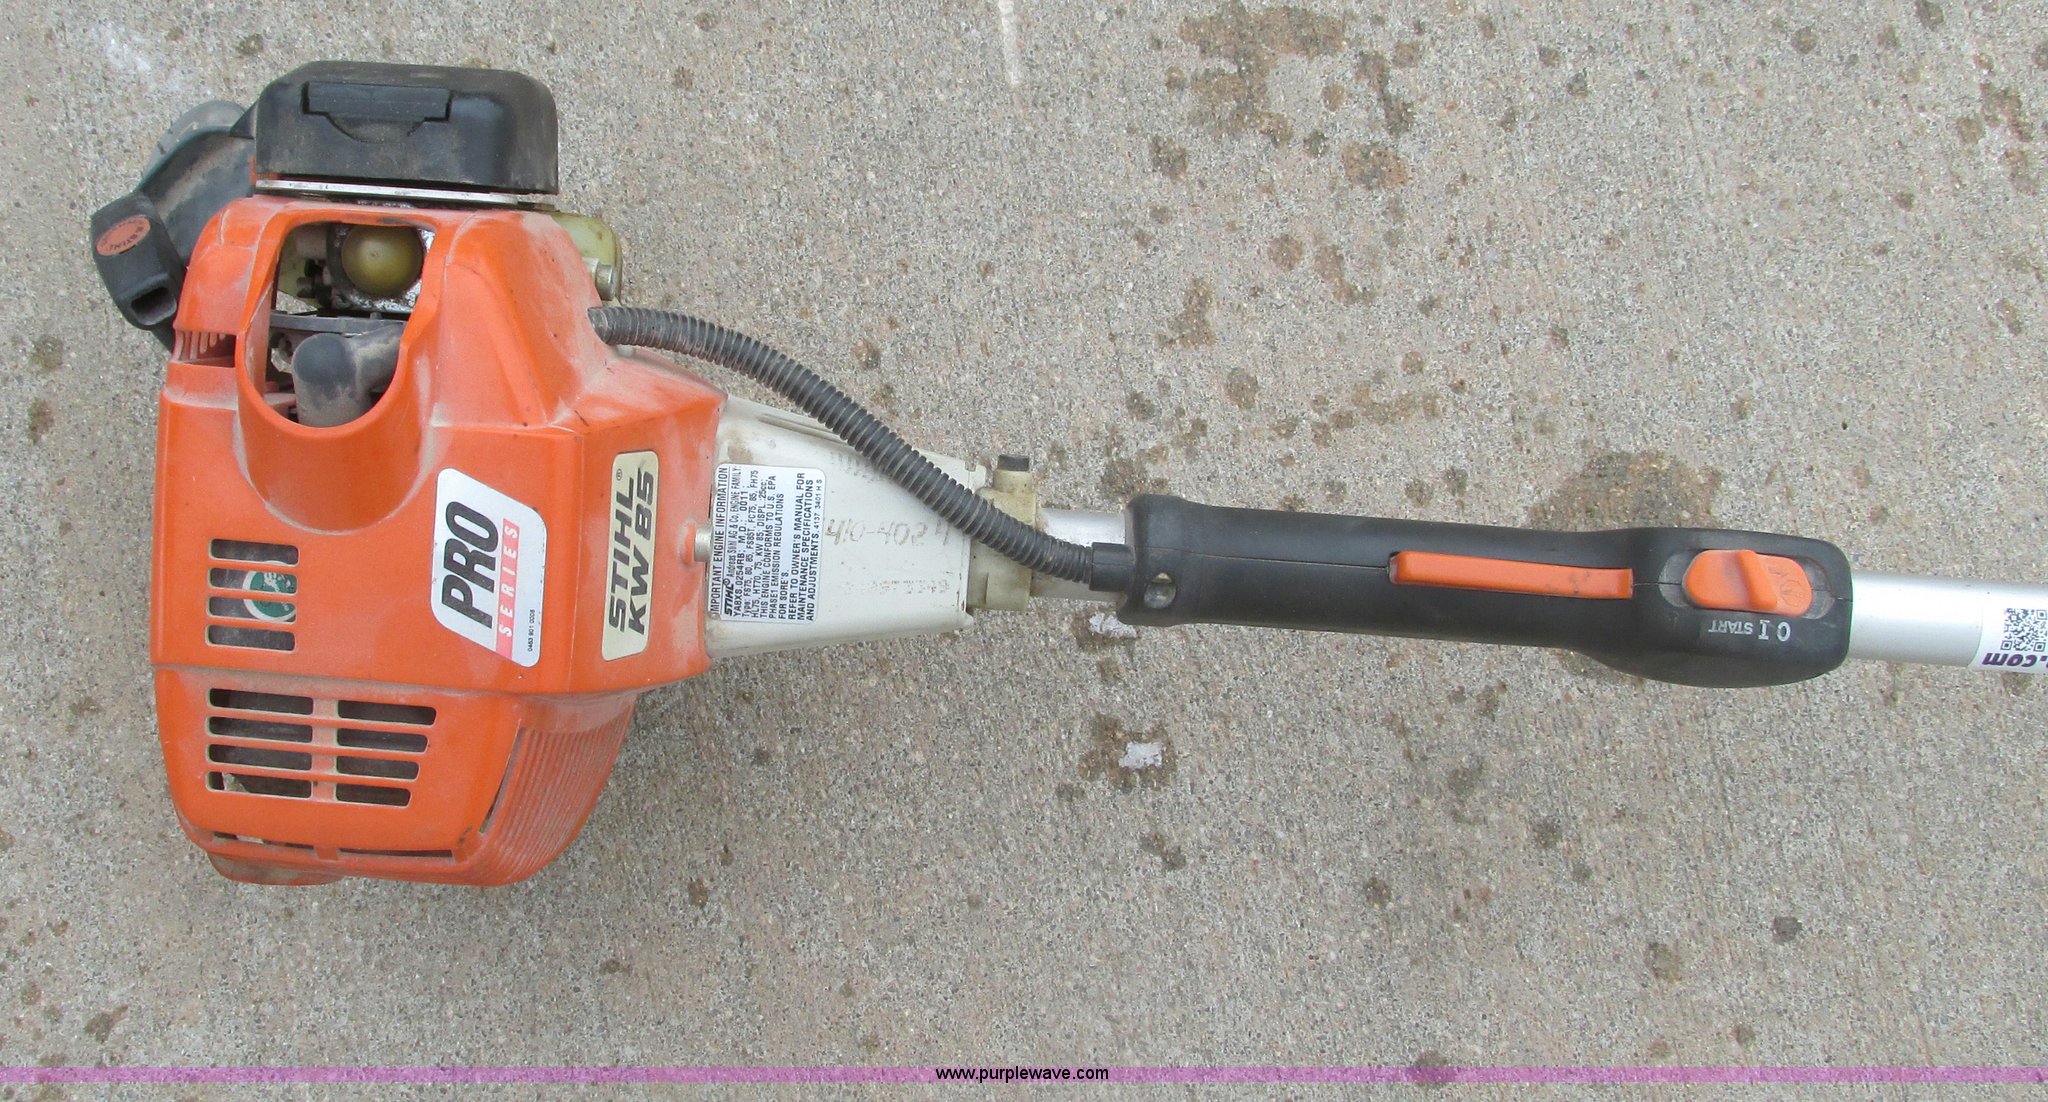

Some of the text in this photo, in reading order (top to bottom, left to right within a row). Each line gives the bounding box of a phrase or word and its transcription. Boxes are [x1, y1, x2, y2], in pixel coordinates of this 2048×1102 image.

[750, 470, 759, 488] FH75
[716, 468, 727, 527] INFORMATION
[730, 492, 740, 512] ENGINE
[740, 491, 748, 511] 0011
[748, 504, 757, 523] FC75,
[608, 476, 634, 632] STIHL
[628, 467, 654, 635] KW 85
[713, 530, 724, 561] ENGINE
[755, 544, 763, 556] KW
[760, 476, 776, 618] THIS ENGINE CONFORMS TO U.S. EPA
[788, 473, 805, 620] REFER TO OWNER'S MANUAL FOR
[797, 479, 814, 620] MAINTENANCE SPECIFICATIONS
[441, 501, 498, 629] PRO
[726, 555, 736, 577] Andreas
[746, 552, 754, 562] 85,
[754, 560, 763, 570] 75,
[769, 494, 784, 618] PHASE1 EMISSION REGULATIONS
[808, 530, 820, 600] ADJUSTMENTS.
[745, 565, 753, 575] 80,
[498, 525, 518, 637] SERIES
[744, 578, 752, 596] FS75,
[753, 574, 761, 594] HT70,
[778, 570, 789, 620] FOR SORE'S.
[742, 599, 750, 617] Type:
[751, 598, 760, 618] HL75,
[806, 603, 815, 621] AND
[1708, 620, 1754, 634] START
[1982, 652, 2048, 669] .com
